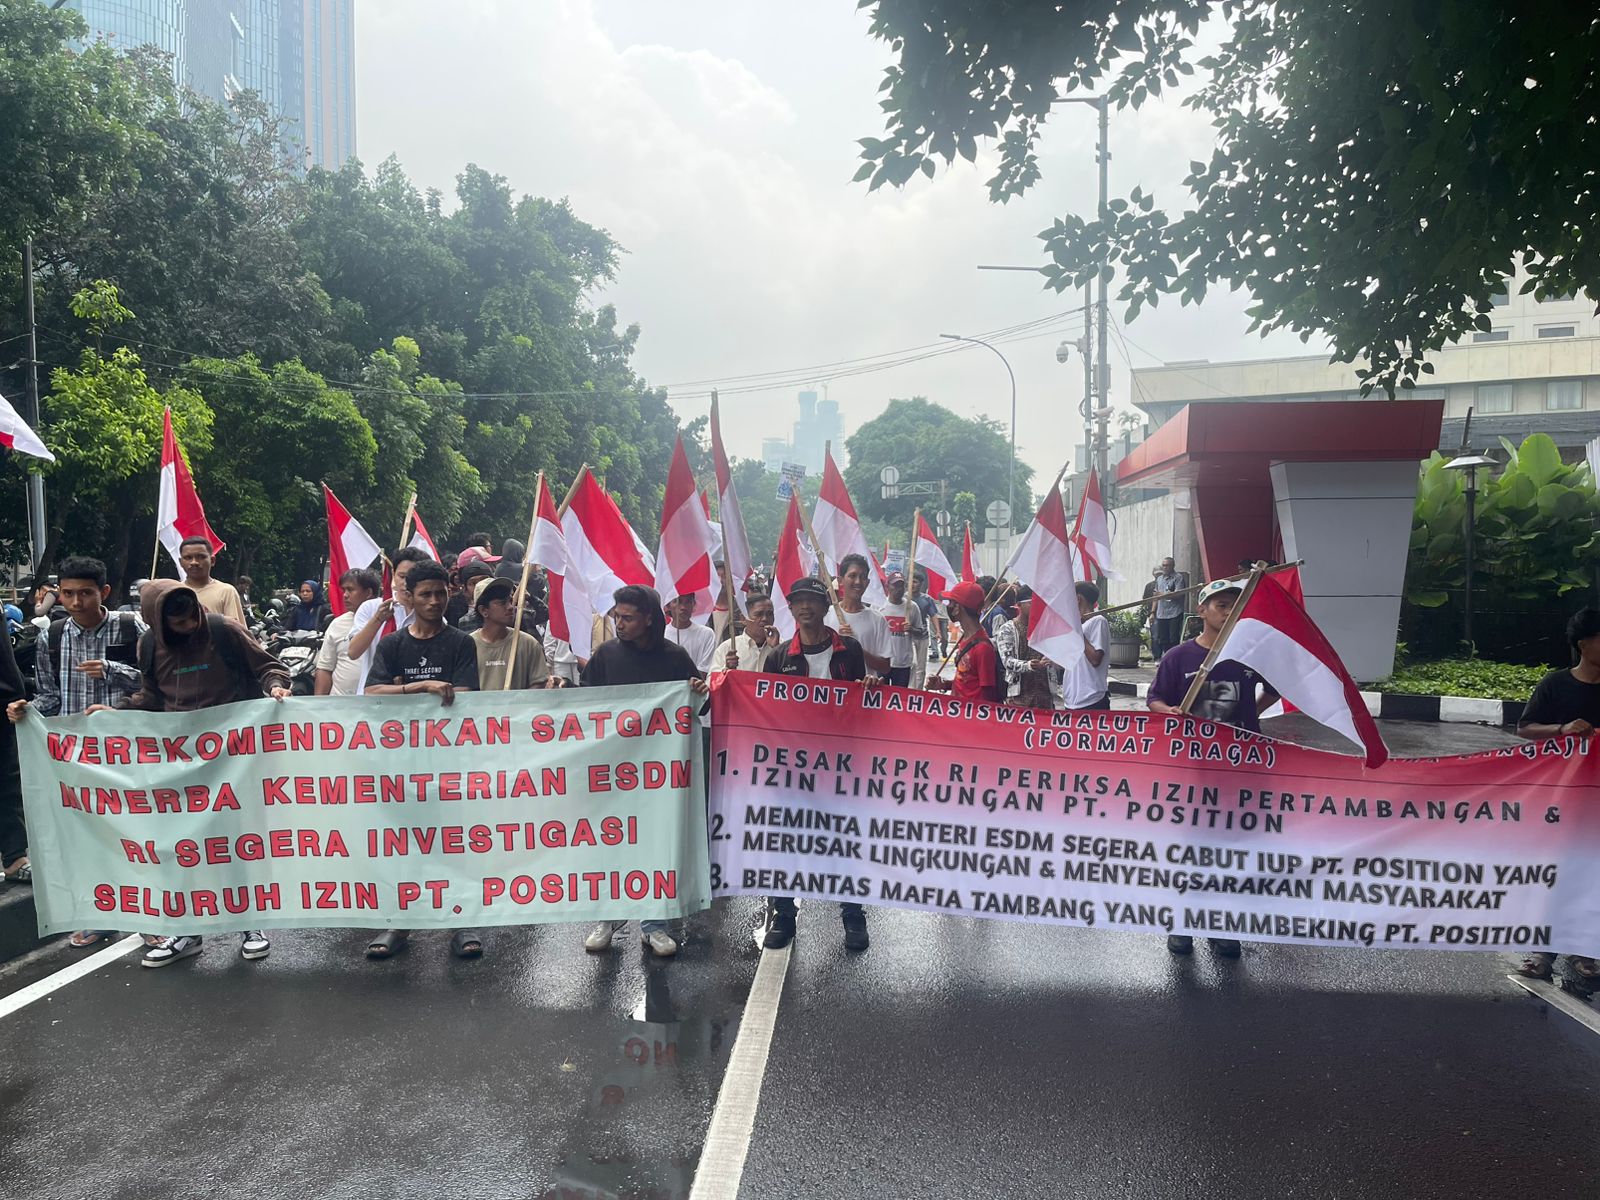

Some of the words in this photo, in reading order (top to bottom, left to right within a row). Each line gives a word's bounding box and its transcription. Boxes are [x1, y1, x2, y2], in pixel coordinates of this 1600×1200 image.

[47, 716, 511, 765] MEREKOMENDASIKAN
[531, 706, 693, 743] SATGAS
[756, 680, 848, 706] FRONT
[862, 690, 1035, 723] MAHASISWA
[1052, 711, 1149, 733] MALUT
[1164, 717, 1216, 738] PRO
[1024, 729, 1154, 755] (FORMAT
[1169, 739, 1276, 768] PRAGA)
[59, 781, 241, 815] MINERBA
[262, 767, 566, 805] KEMENTERIAN
[588, 760, 691, 793] ESDM
[716, 749, 739, 776] 1.
[753, 744, 852, 773] DESAK
[871, 756, 930, 780] KPK
[949, 764, 979, 784] RI
[997, 767, 1132, 797] PERIKSA
[1152, 782, 1218, 806] IZIN
[1239, 789, 1521, 824] PERTAMBANGAN
[1544, 806, 1561, 824] &
[752, 766, 816, 792] IZIN
[835, 776, 1044, 813] LINGKUNGAN
[1064, 796, 1106, 818] PT.
[1126, 801, 1283, 833] POSITION
[120, 839, 160, 865] RI
[175, 829, 349, 868] SEGERA
[367, 815, 637, 858] INVESTIGASI
[711, 814, 731, 841] 2.
[744, 805, 861, 837] MEMINTA
[869, 818, 978, 847] MENTERI
[985, 827, 1053, 851] ESDM
[1062, 834, 1158, 861] SEGERA
[1166, 844, 1249, 871] CABUT
[1257, 852, 1303, 875] IUP
[1310, 857, 1343, 875] PT.
[1353, 857, 1483, 884] POSITION
[1494, 864, 1558, 888] YANG
[742, 831, 863, 860] MERUSAK
[870, 844, 1031, 879] LINGKUNGAN
[1039, 860, 1055, 878] &
[1064, 860, 1313, 898] MENYENGSARAKAN
[1323, 880, 1506, 910] MASYARAKAT
[94, 882, 281, 917] SELURUH
[300, 882, 378, 910] IZIN
[397, 879, 462, 915] PT.
[483, 870, 677, 906] POSITION
[710, 863, 729, 891] 3.
[742, 869, 871, 897] BERANTAS
[880, 880, 961, 910] MAFIA
[971, 891, 1095, 926] TAMBANG
[1104, 902, 1174, 932] YANG
[1184, 907, 1376, 946] MEMMBEKING
[1384, 924, 1419, 943] PT.
[1429, 924, 1553, 946] POSITION
